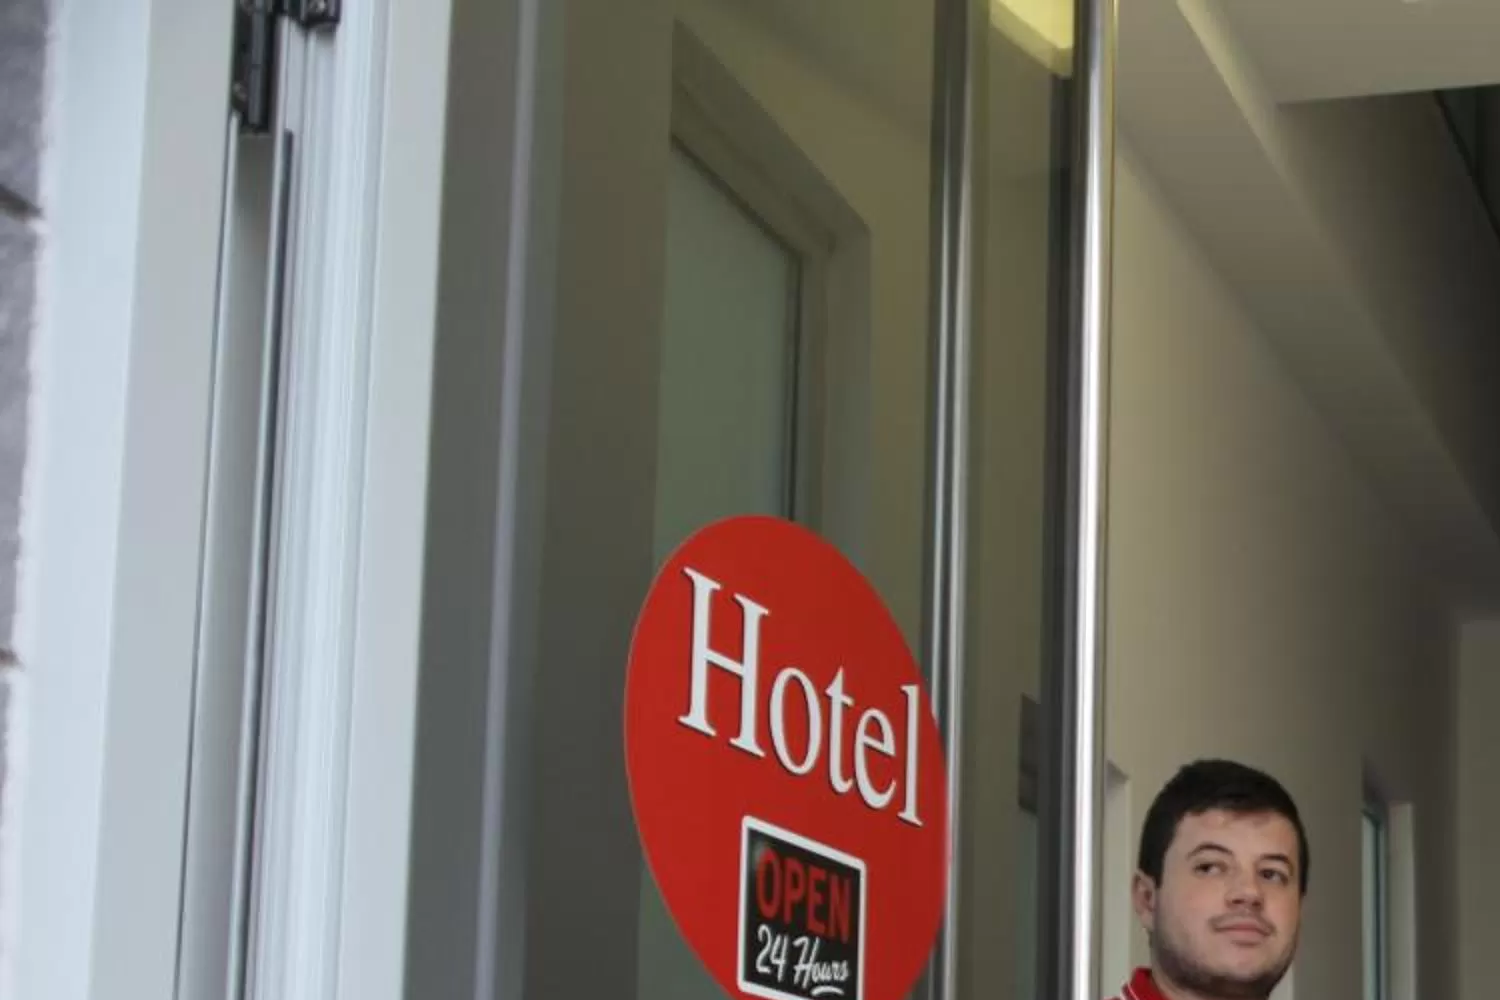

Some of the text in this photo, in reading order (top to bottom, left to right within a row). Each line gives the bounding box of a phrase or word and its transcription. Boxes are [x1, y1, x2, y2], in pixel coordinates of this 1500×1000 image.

[678, 567, 923, 826] Hotel
[757, 847, 850, 943] OPEN
[756, 925, 849, 989] 24 Hours
